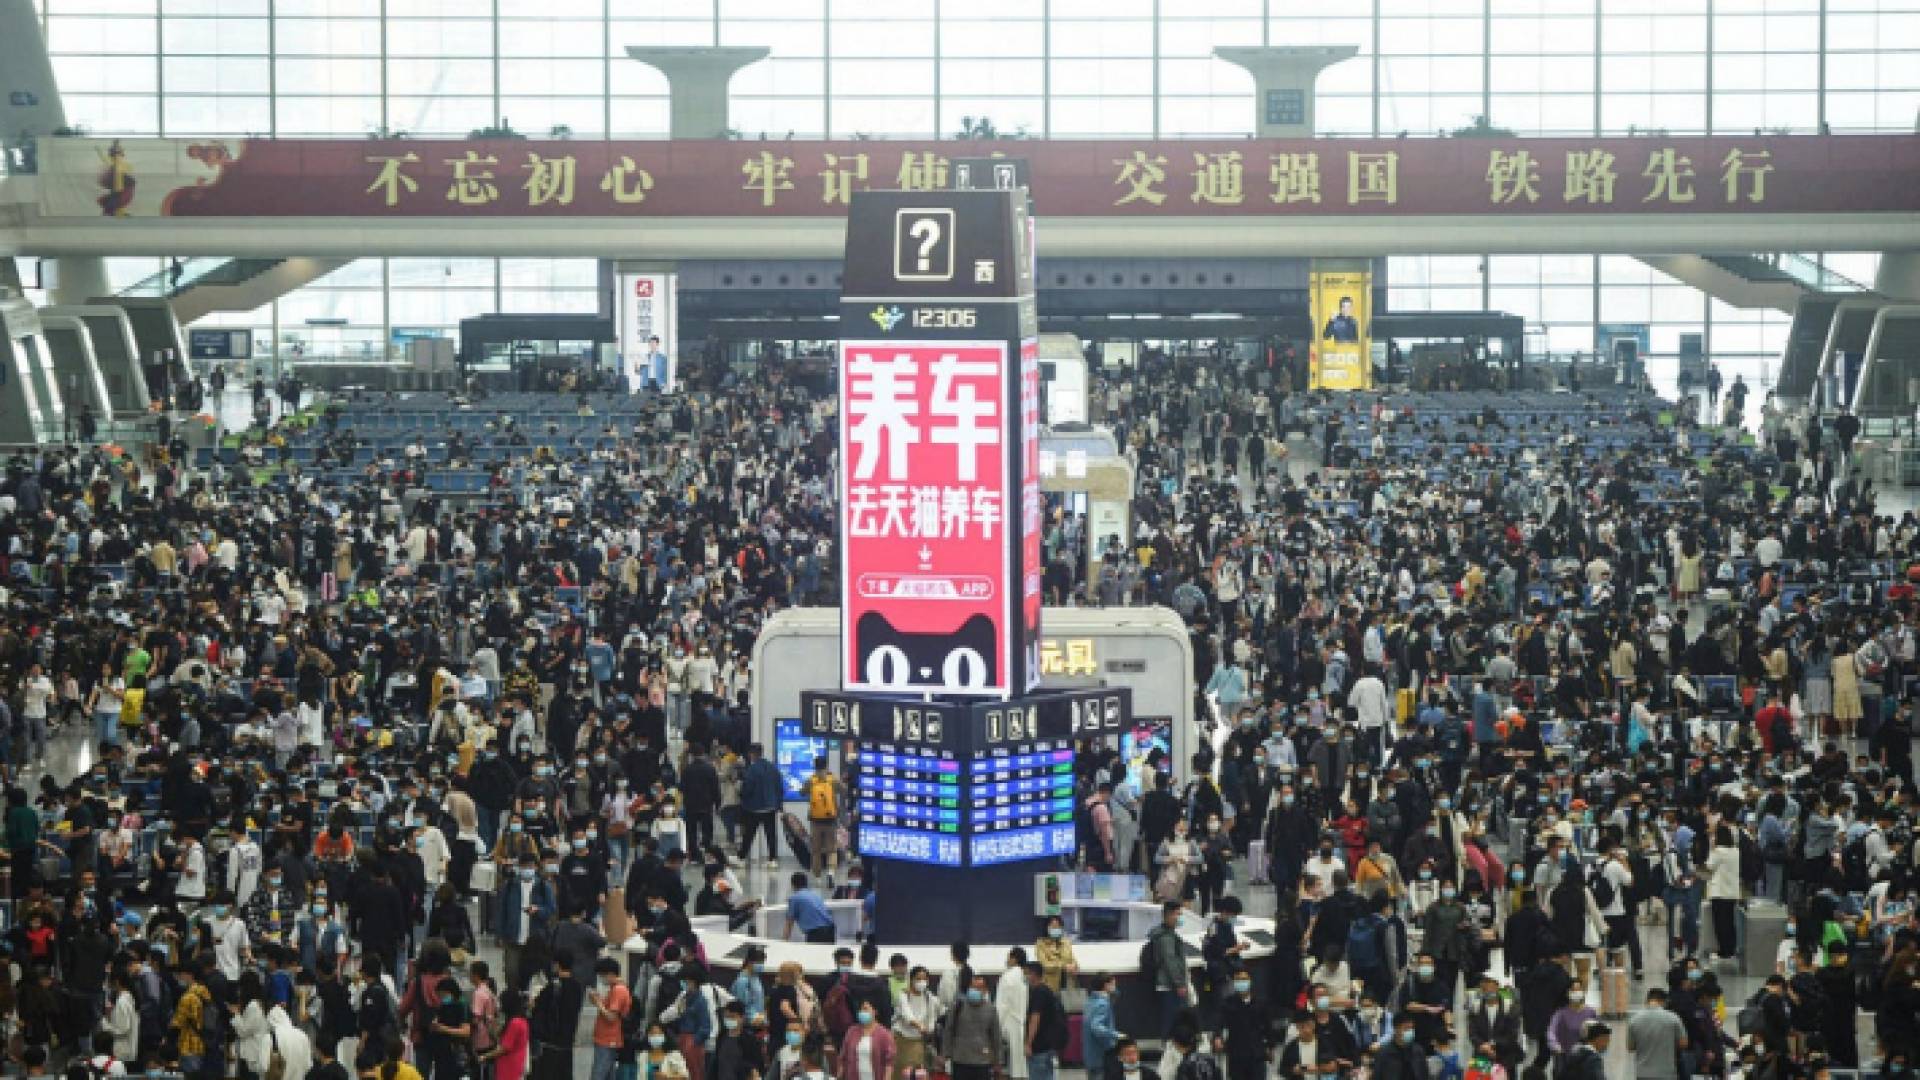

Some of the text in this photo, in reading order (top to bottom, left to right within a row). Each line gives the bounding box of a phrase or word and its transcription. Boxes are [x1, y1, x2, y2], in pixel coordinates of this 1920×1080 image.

[365, 148, 1775, 206] 不忘初心 牢记使 交通强国 铁路先行
[911, 307, 977, 328] 12306
[850, 353, 1000, 481] 养车
[850, 485, 1001, 538] 去天猫养车
